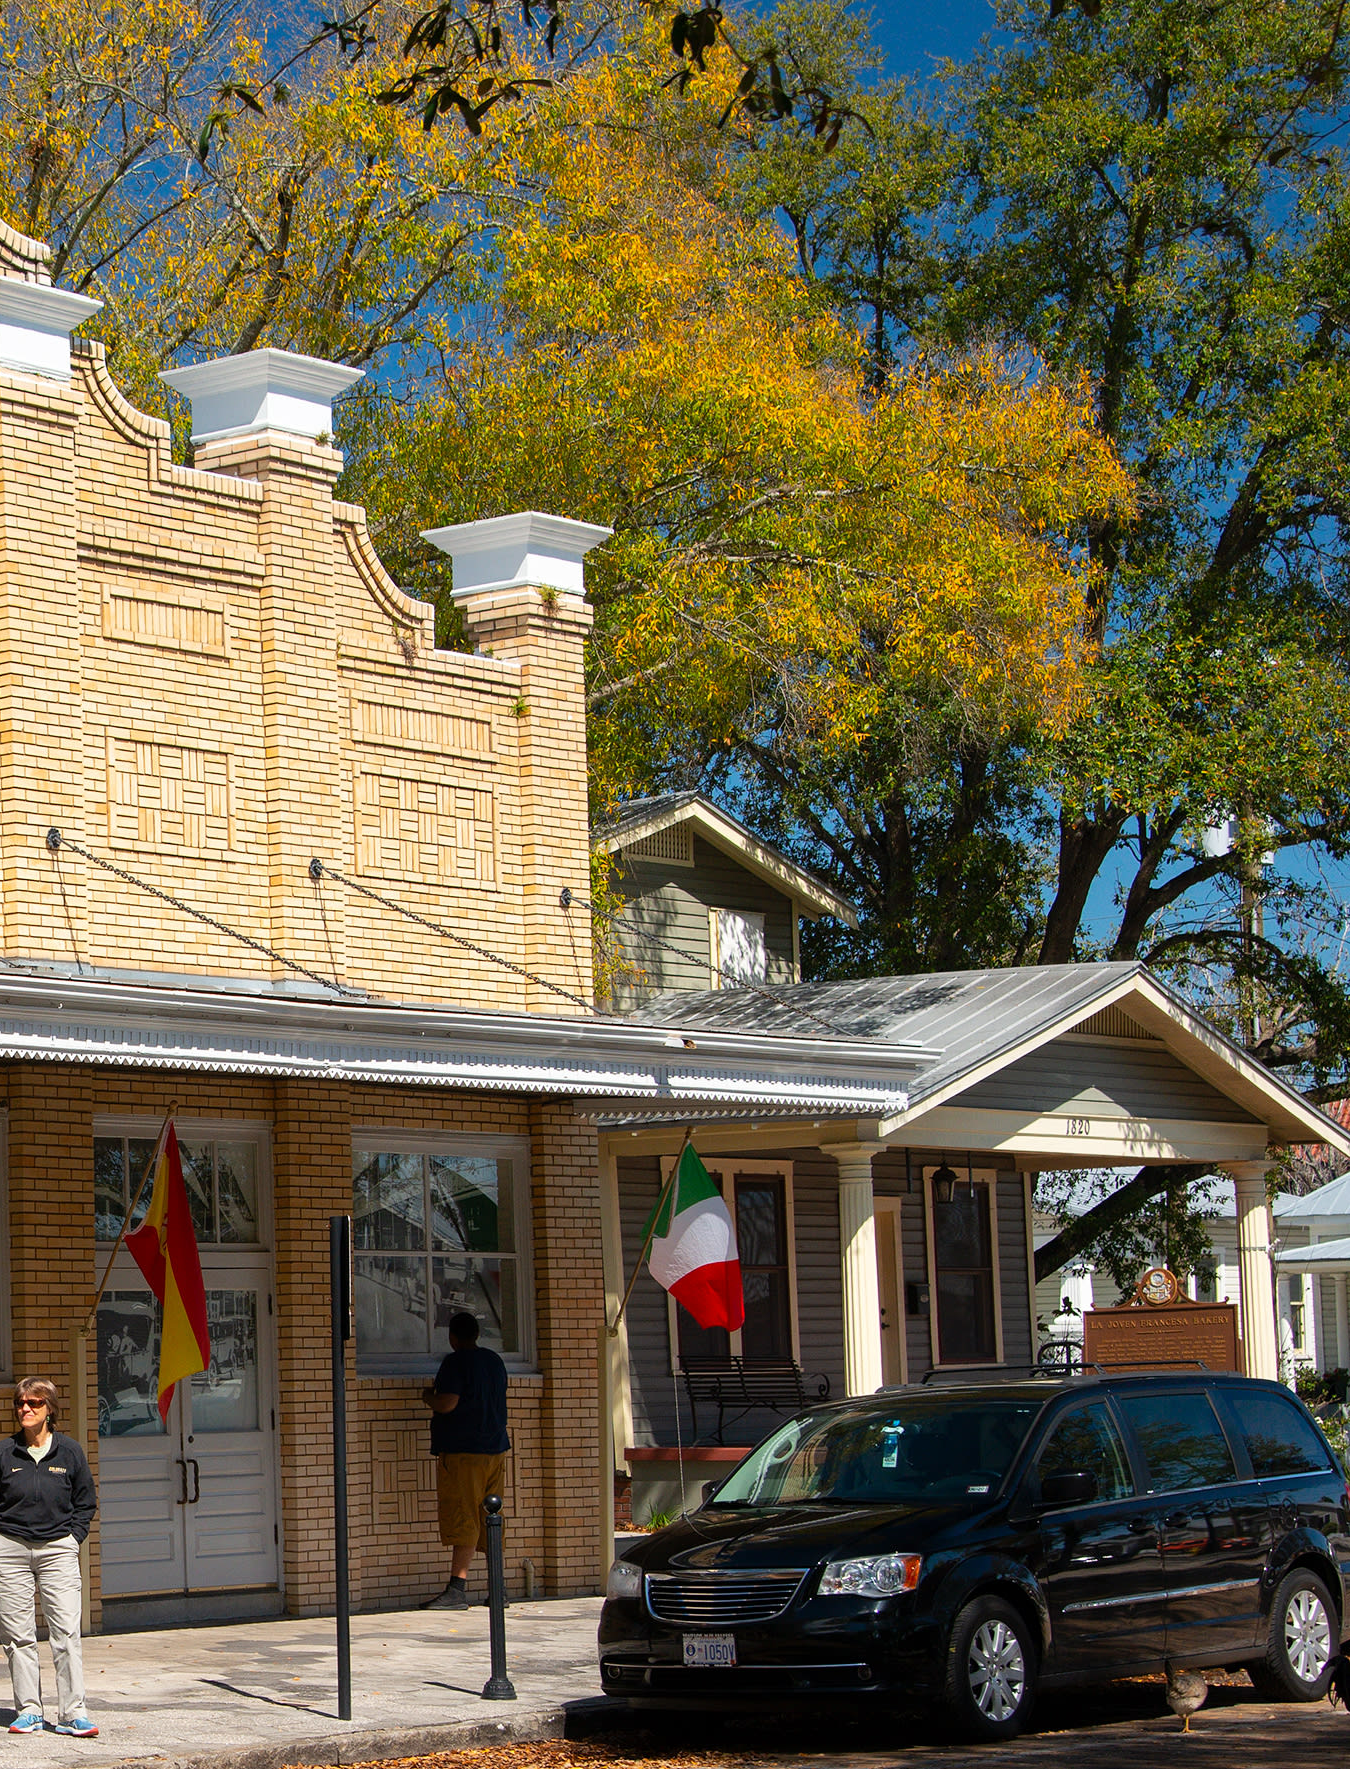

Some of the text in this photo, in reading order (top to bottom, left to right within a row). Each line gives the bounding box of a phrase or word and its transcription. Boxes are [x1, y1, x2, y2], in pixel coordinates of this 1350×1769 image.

[1066, 1118, 1091, 1136] 1820
[1090, 1315, 1229, 1330] LA JOVEN FRANCESA BAKERY
